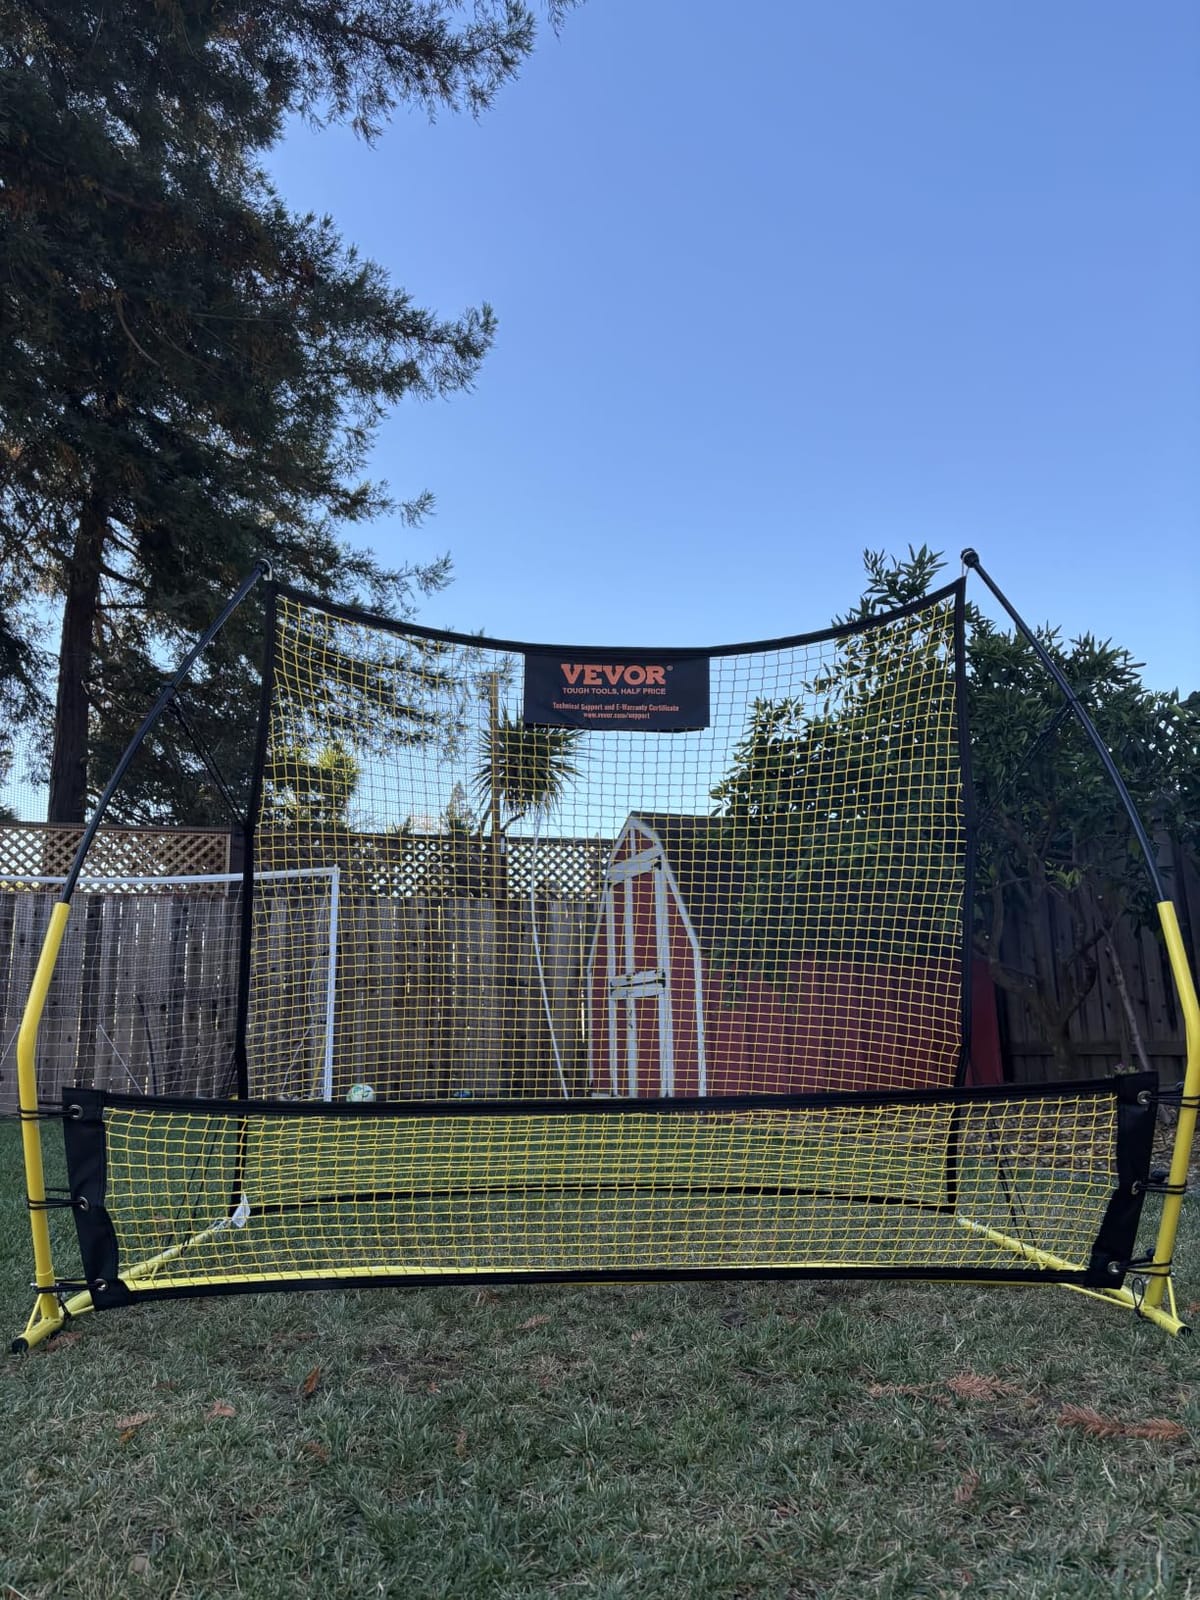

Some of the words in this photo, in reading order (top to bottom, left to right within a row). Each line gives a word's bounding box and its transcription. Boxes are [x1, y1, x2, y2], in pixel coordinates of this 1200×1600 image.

[563, 687, 590, 695] TOUGH
[642, 687, 667, 695] PRICE
[553, 701, 580, 710] Technical
[581, 703, 604, 712] Support
[616, 703, 648, 712] E-Warranty
[648, 703, 680, 712] Certificate
